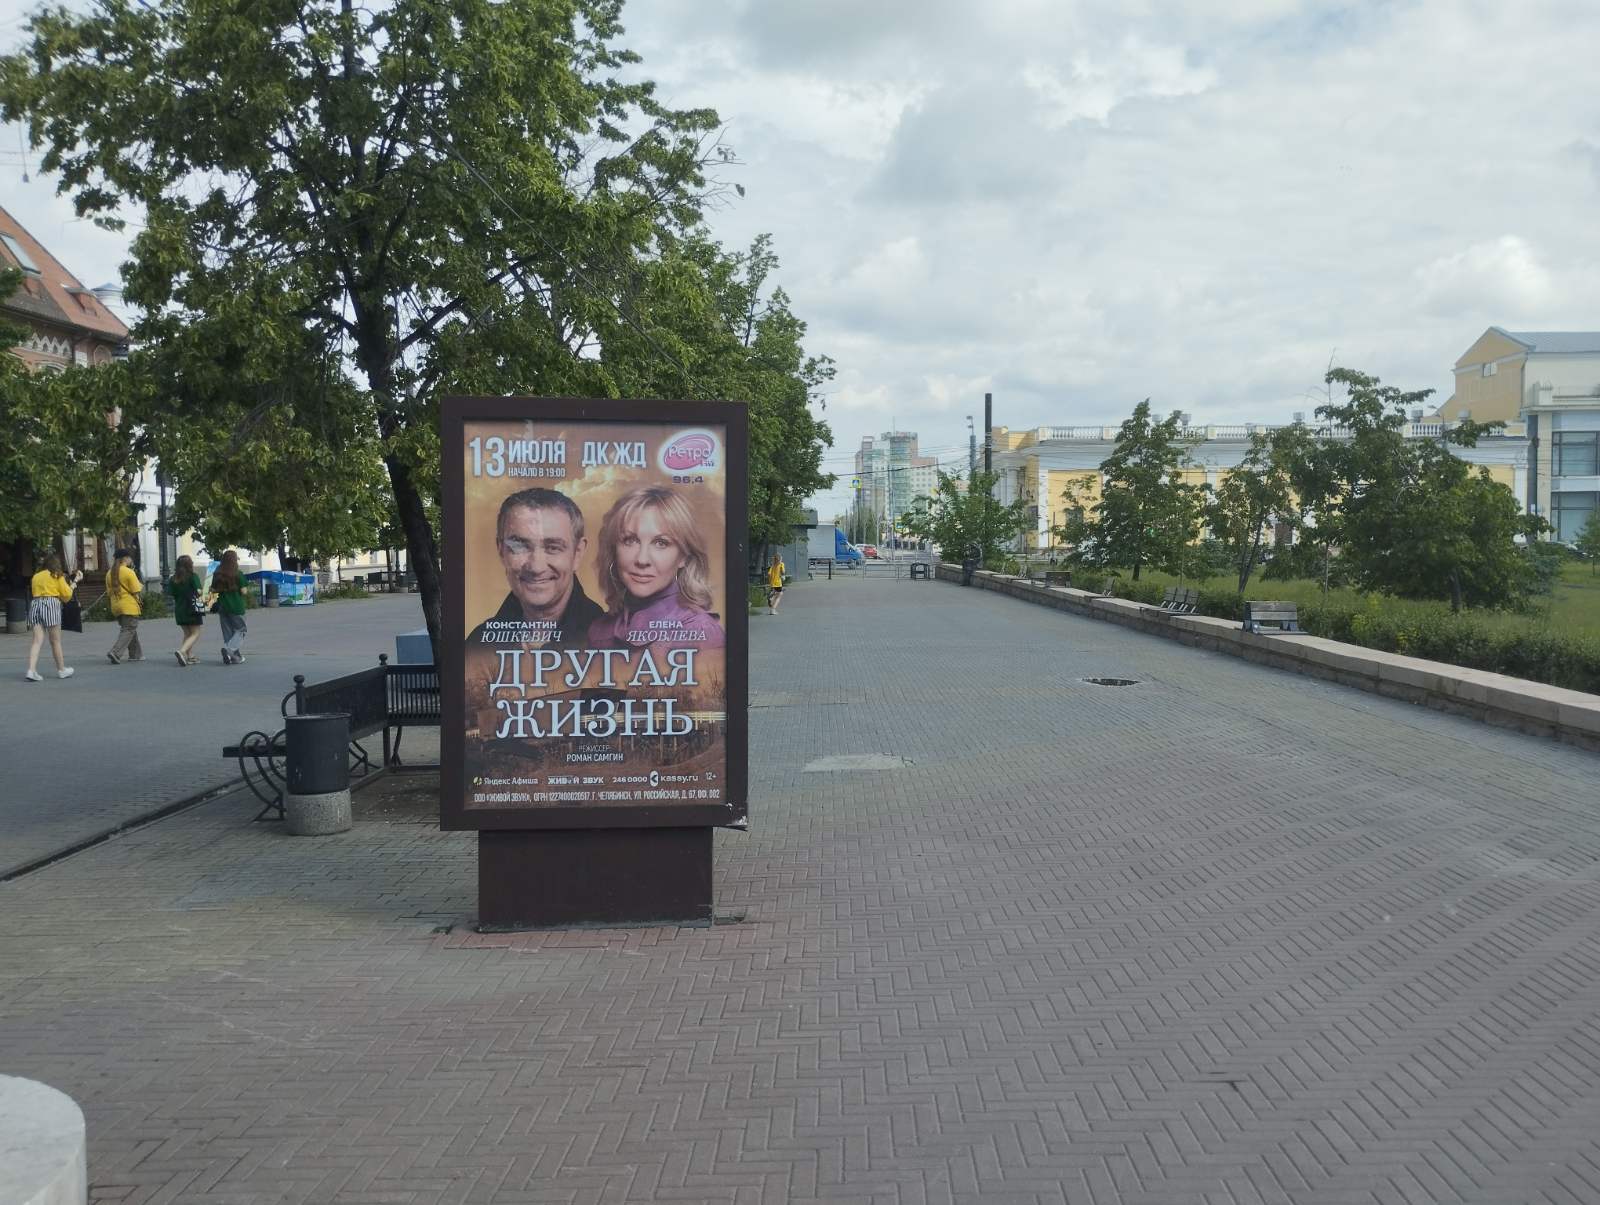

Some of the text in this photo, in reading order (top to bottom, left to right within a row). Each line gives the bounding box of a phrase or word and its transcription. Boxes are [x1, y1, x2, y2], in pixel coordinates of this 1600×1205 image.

[469, 436, 566, 477] 13 ИЮЛЯ
[582, 441, 646, 468] ДК ЖД
[668, 445, 711, 461] Ретро
[508, 467, 566, 477] НАЧАЛО В 19:00
[486, 621, 557, 629] КОНСТАНТИН
[649, 621, 683, 629] ЕЛЕНА
[480, 630, 562, 643] ЮШКЕВИЧ
[626, 630, 707, 642] ЯКОВЛЕВА
[489, 649, 698, 697] ДРУГАЯ
[495, 699, 693, 738] ЖИЗНЬ
[593, 753, 624, 761] САМГИН
[483, 776, 539, 786] Яндекс Афиша
[582, 776, 604, 784] ЗВУК
[660, 775, 699, 784] kassy.ru
